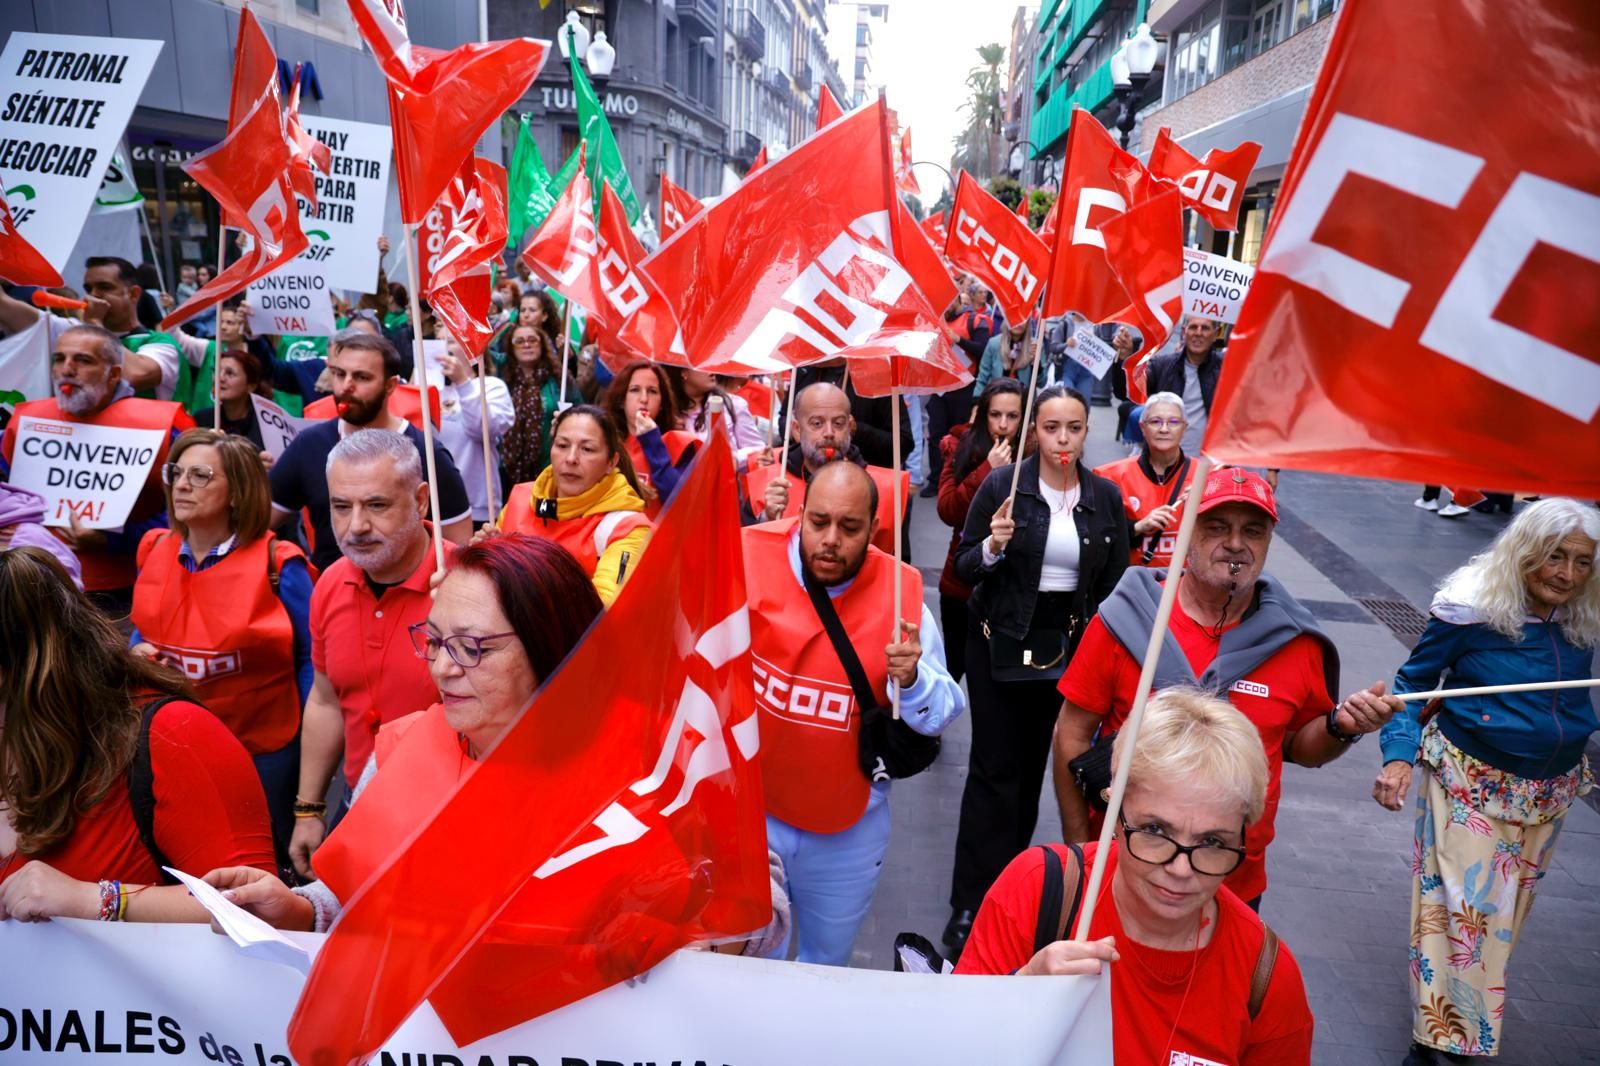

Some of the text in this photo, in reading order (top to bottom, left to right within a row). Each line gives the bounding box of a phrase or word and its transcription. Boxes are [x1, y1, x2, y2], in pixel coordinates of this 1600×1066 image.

[16, 49, 129, 84] PATRONAL
[1, 90, 105, 130] SIÉNTATE
[541, 87, 639, 115] TUMO
[315, 177, 356, 201] PARA
[299, 244, 335, 262] SIF
[956, 207, 1038, 302] CCOO
[1188, 278, 1241, 301] DIGNO
[262, 295, 310, 310] DIGNO
[1192, 299, 1227, 318] ¡YA!
[274, 316, 308, 332] ¡YA!
[22, 437, 153, 466] CONVENIO
[47, 467, 125, 491] DIGNO
[55, 499, 105, 522] ¡YA!
[1236, 681, 1267, 695] CCOO
